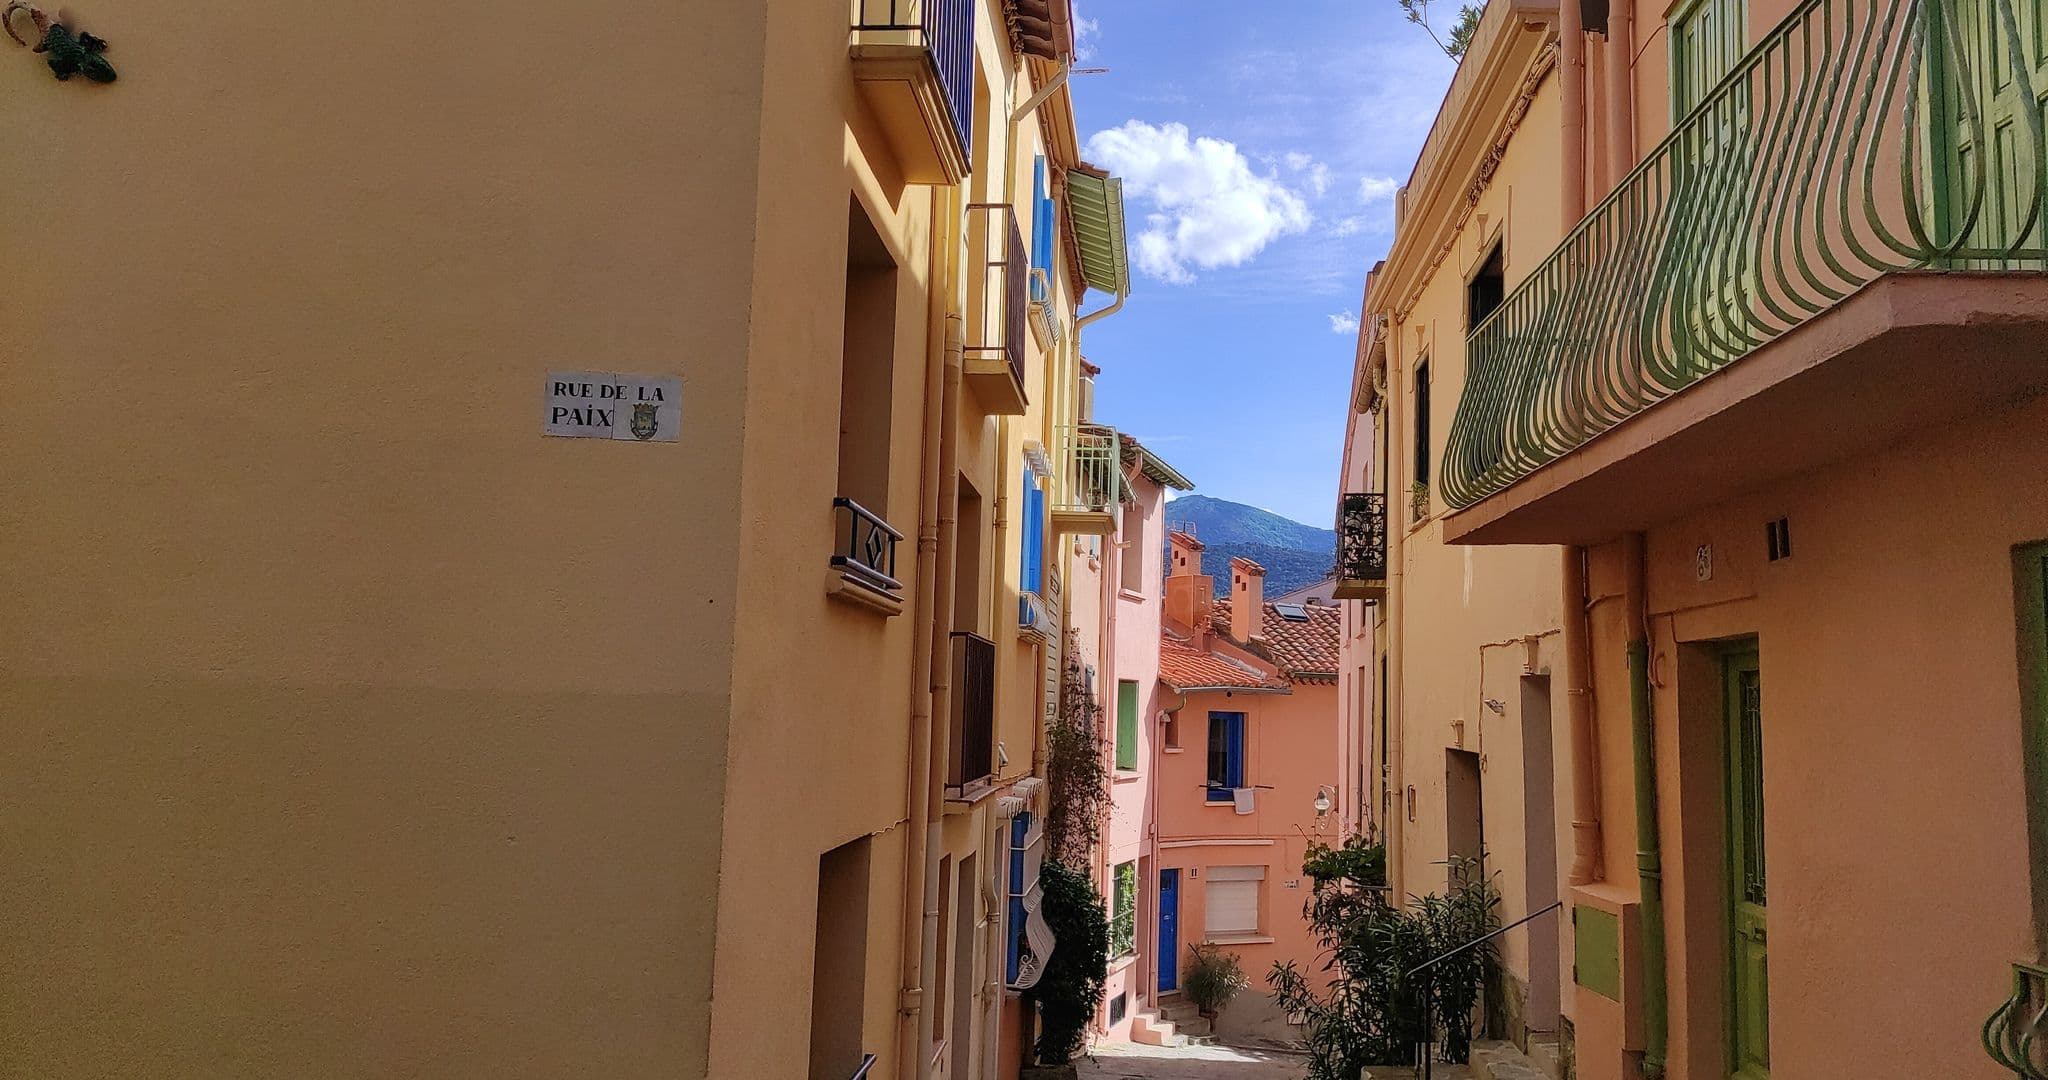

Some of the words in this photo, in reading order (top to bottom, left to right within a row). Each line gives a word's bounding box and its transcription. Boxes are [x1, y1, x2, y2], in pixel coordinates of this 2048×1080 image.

[553, 382, 593, 398] RUE
[600, 384, 627, 400] DE
[638, 386, 664, 401] LA
